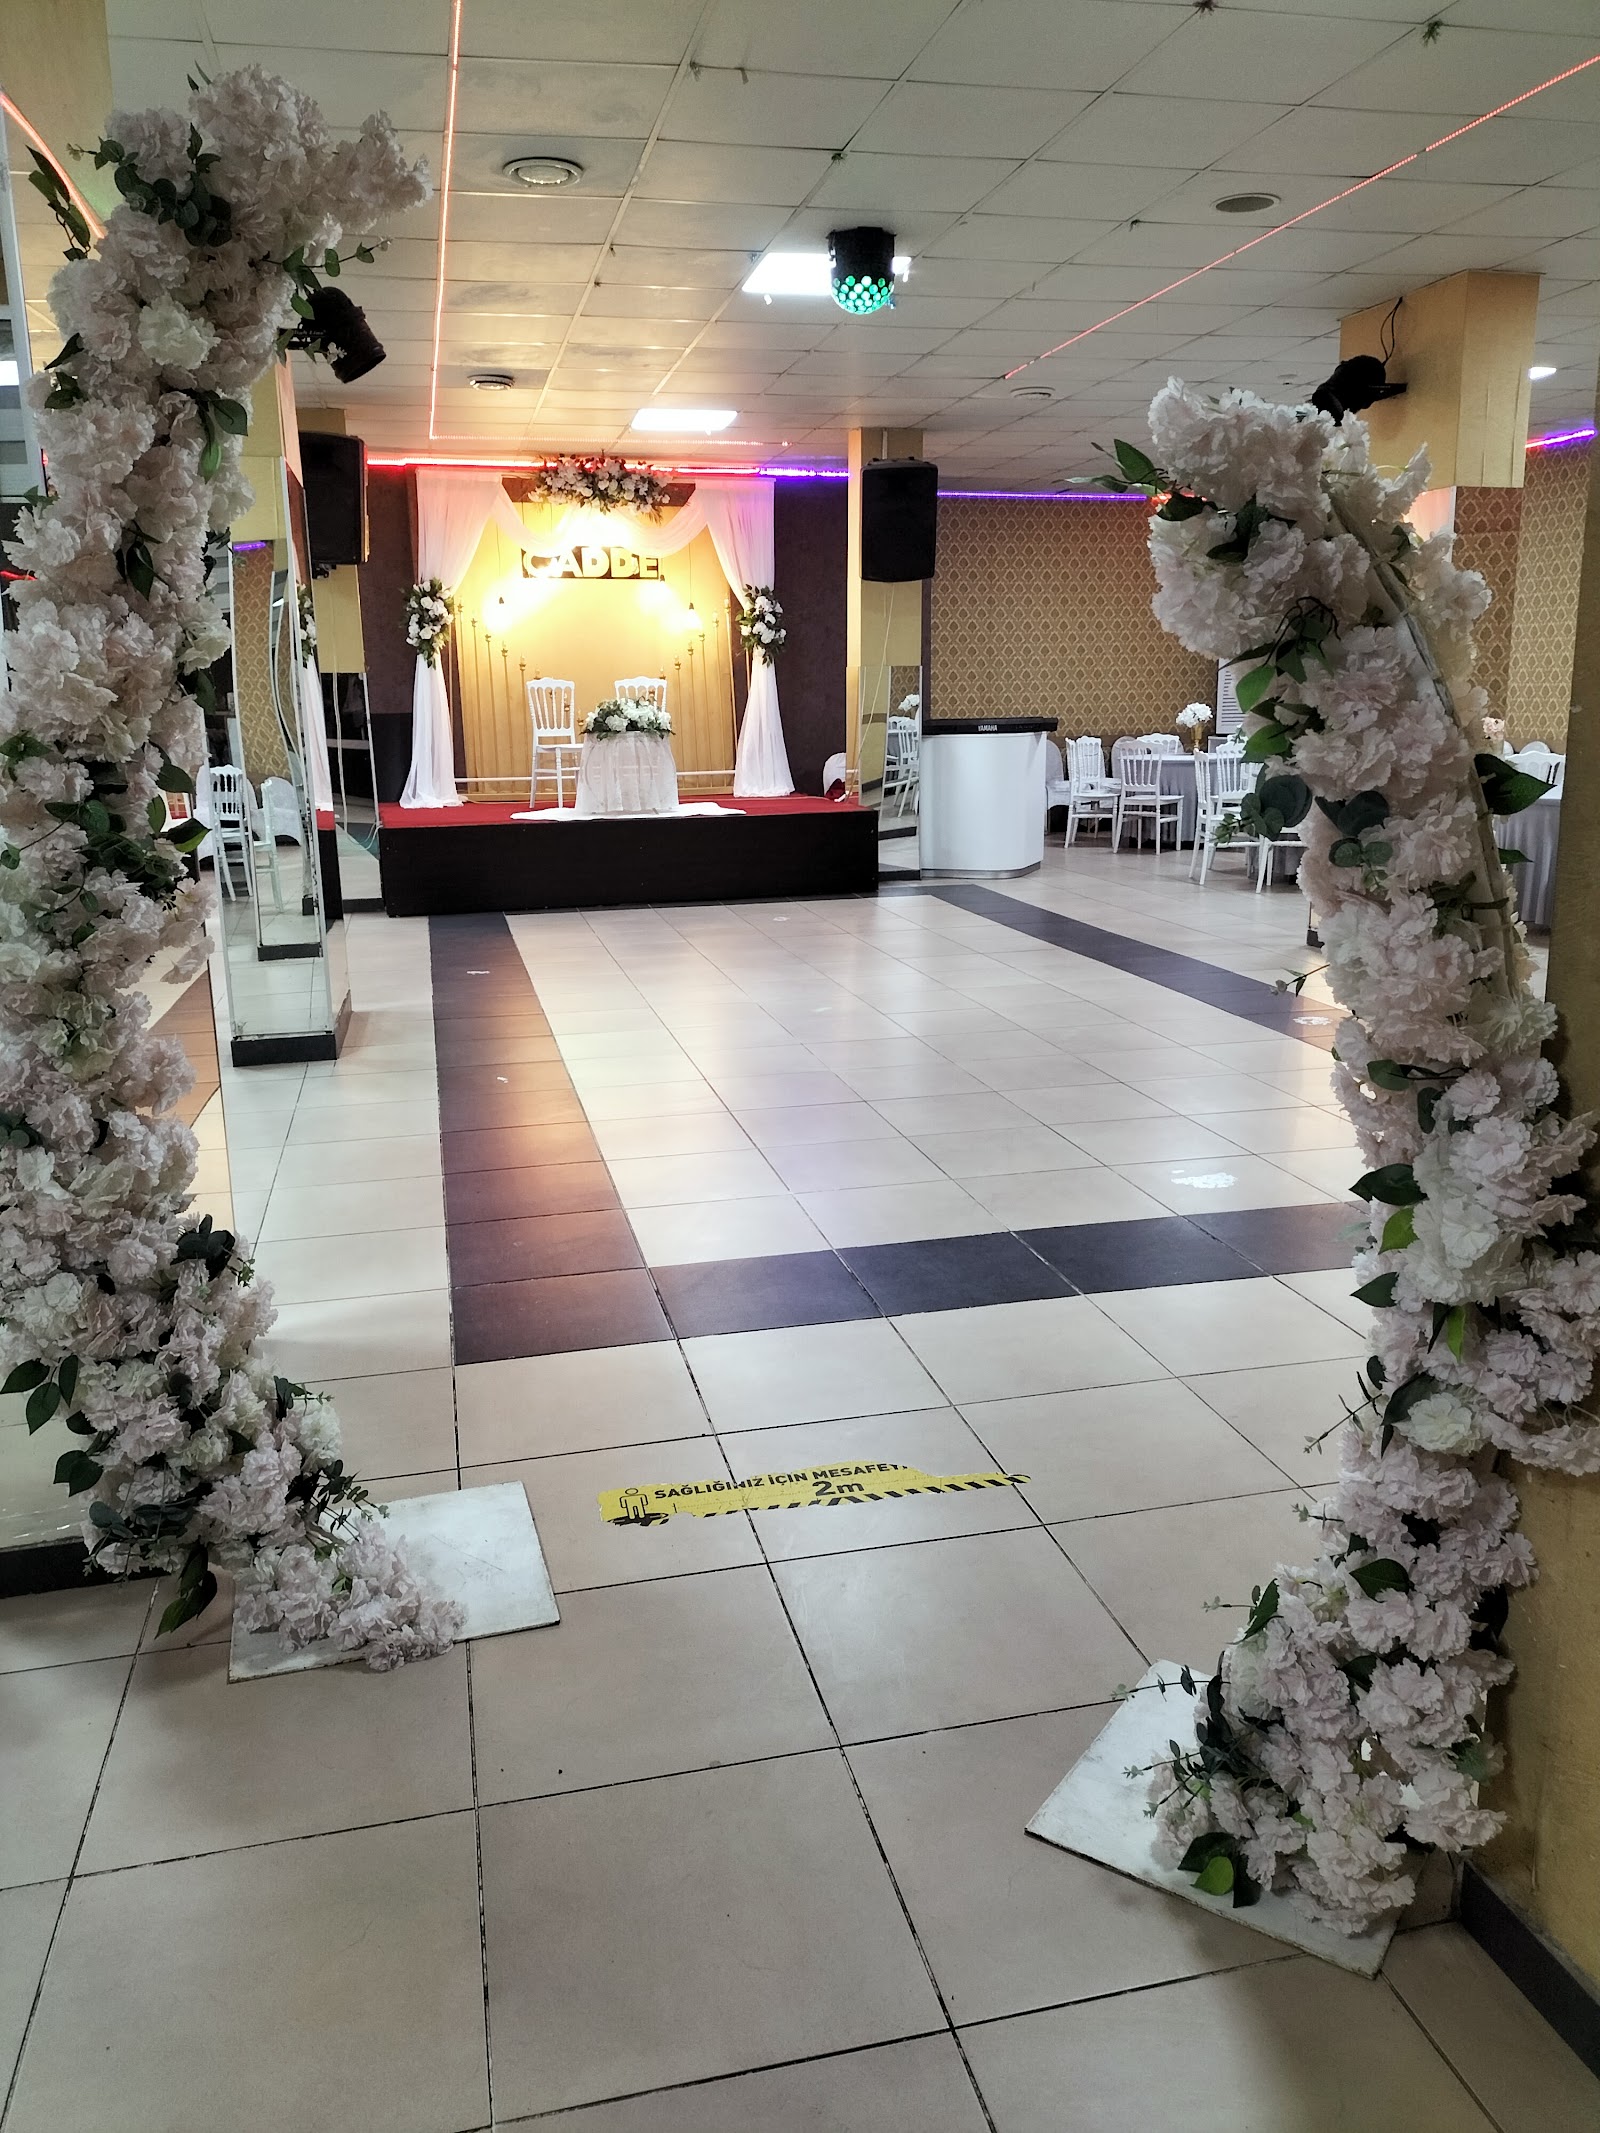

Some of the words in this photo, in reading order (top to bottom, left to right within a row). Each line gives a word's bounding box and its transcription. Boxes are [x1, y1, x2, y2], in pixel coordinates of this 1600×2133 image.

[521, 545, 659, 580] CADDE
[977, 724, 998, 732] YAMAHA
[811, 1480, 865, 1497] 2m
